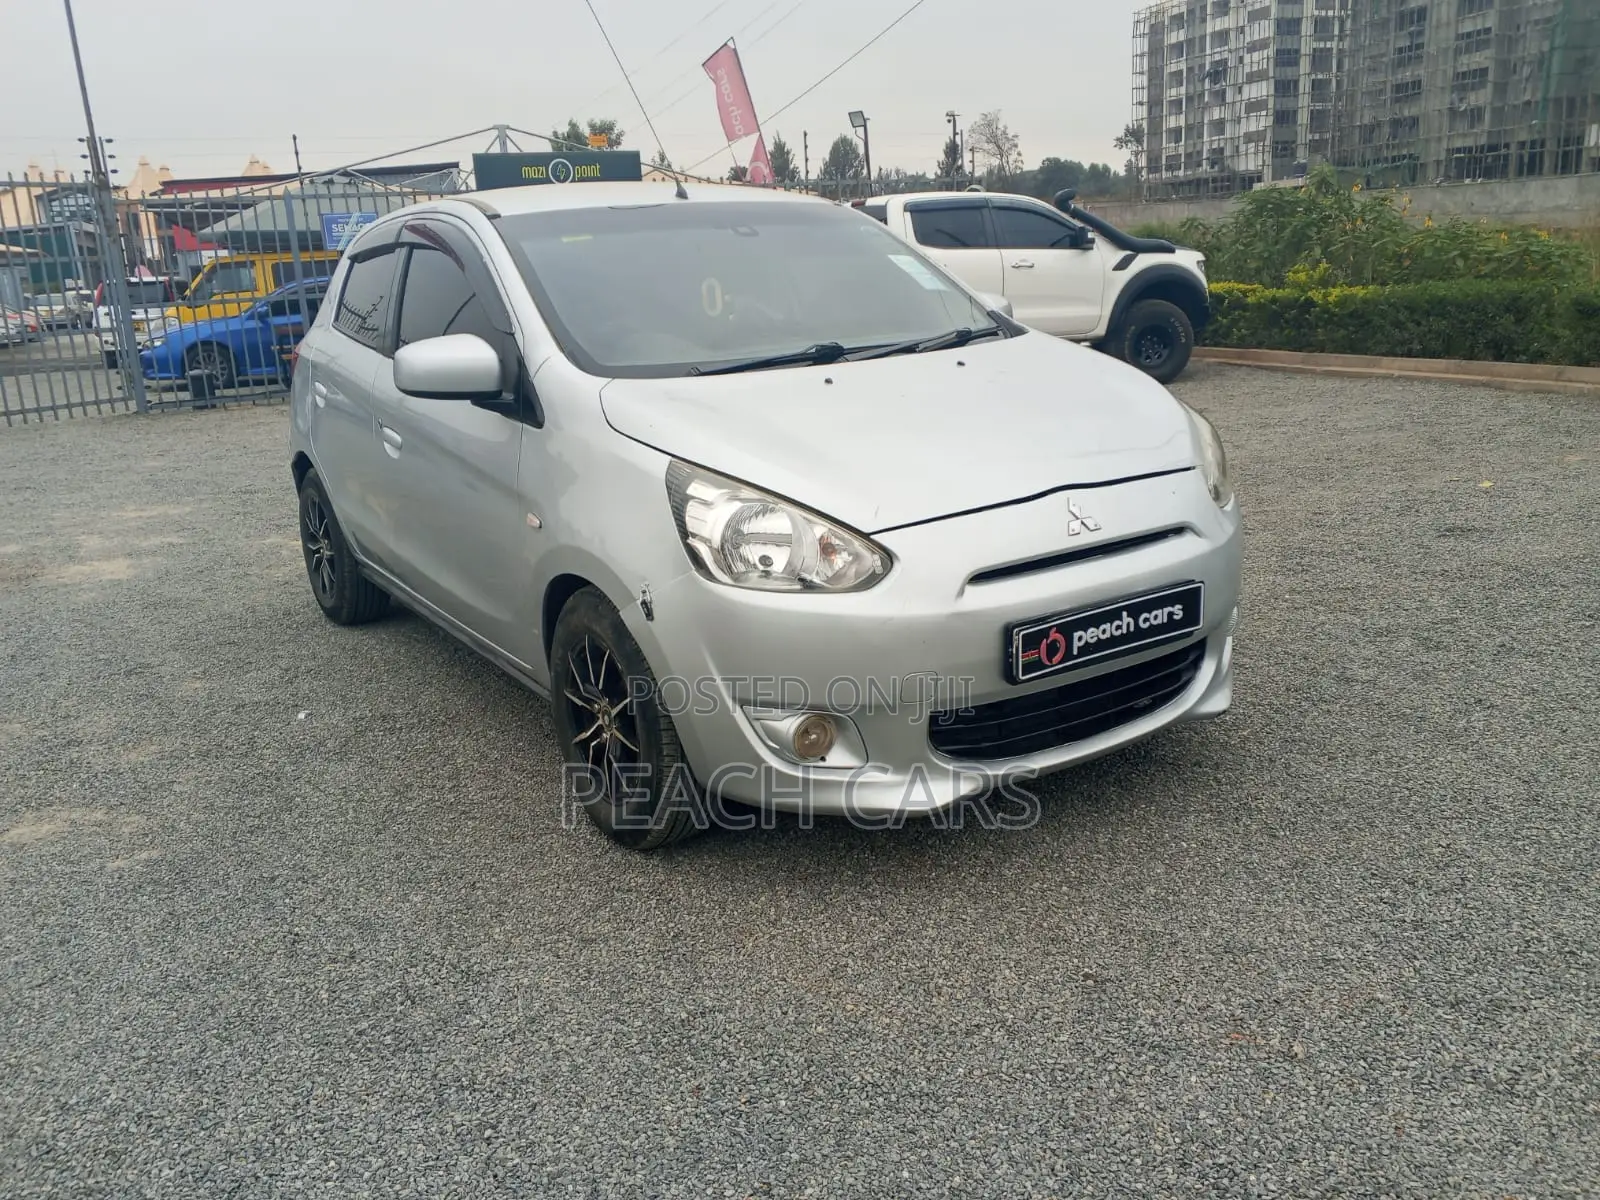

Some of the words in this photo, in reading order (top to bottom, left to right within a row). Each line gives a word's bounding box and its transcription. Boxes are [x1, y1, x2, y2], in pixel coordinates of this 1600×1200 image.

[575, 162, 601, 181] point
[1072, 611, 1135, 655] peach
[1138, 603, 1184, 629] cars
